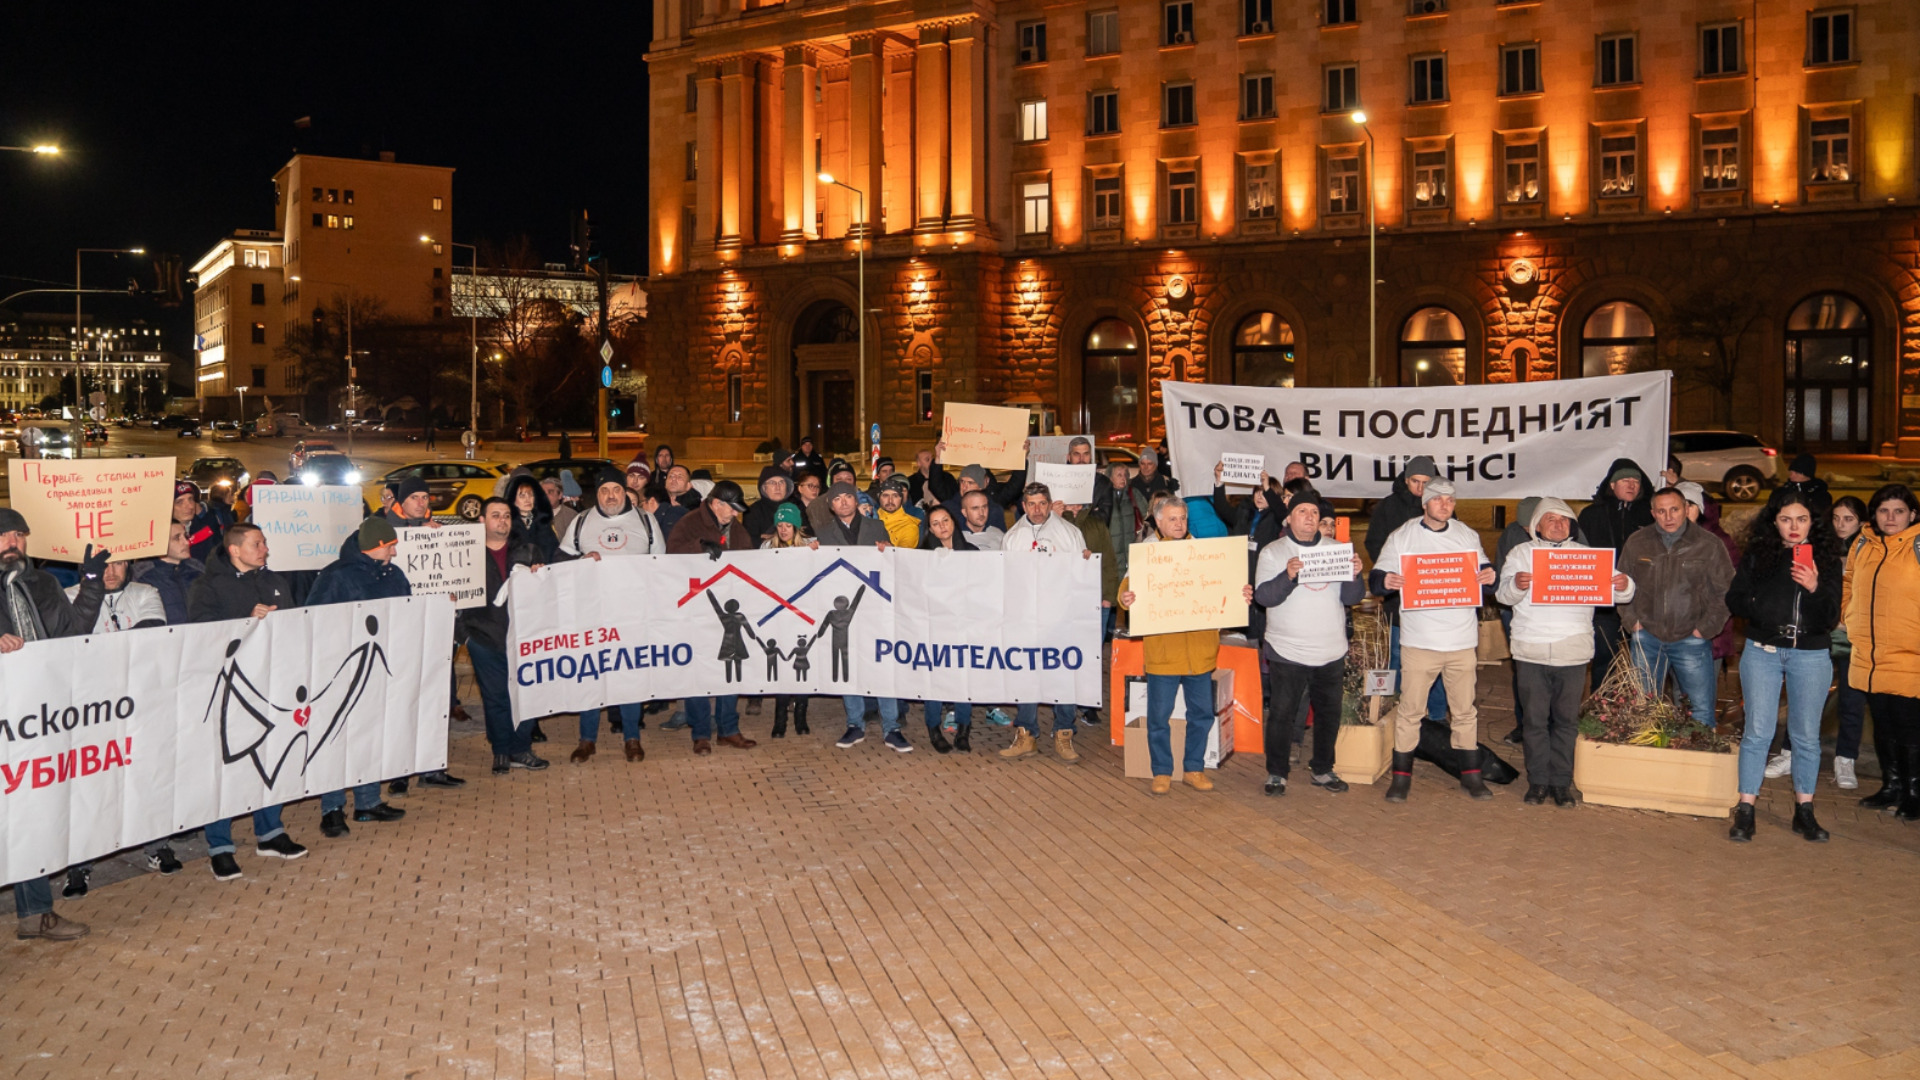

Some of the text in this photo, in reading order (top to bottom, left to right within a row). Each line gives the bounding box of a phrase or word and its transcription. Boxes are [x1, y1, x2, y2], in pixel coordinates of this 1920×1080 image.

[1181, 395, 1642, 444] ТОВА Е ПОСЛЕДНИЯТ
[1300, 452, 1353, 482] ВИ
[257, 488, 315, 504] РАВНИ
[75, 510, 114, 539] НЕ
[1416, 556, 1464, 565] Родителите
[1549, 551, 1597, 560] Родителите
[1417, 567, 1464, 576] заслужават
[1549, 563, 1597, 572] заслужават
[1420, 577, 1461, 585] споделена
[1416, 587, 1467, 598] отговорност
[1547, 584, 1598, 592] отговорност
[1421, 599, 1446, 607] равни
[1447, 597, 1472, 606] права
[1578, 595, 1603, 603] права
[520, 627, 621, 657] ВРЕМЕ Е ЗА
[875, 638, 1083, 672] РОДИТЕЛСТВО
[517, 642, 693, 687] СПОДЕЛЕНО
[0, 736, 133, 795] УБИВА!
